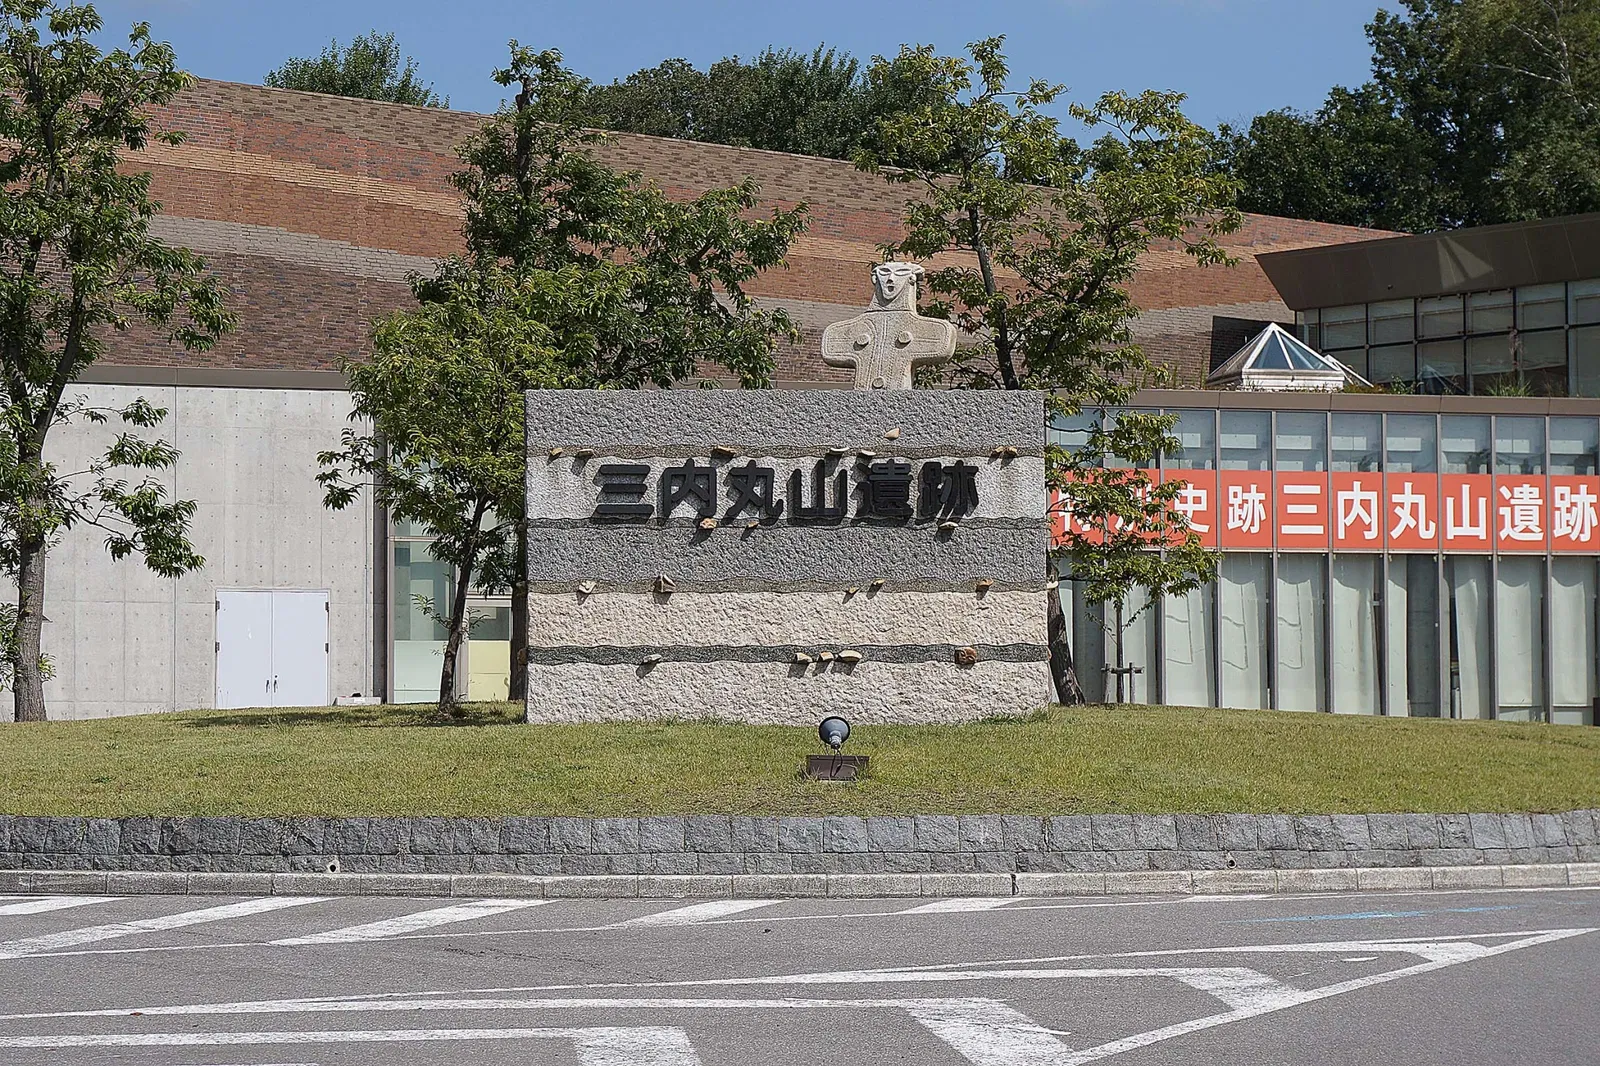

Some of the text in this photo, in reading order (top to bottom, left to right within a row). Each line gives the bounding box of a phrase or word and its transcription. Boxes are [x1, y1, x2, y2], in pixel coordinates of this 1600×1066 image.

[594, 458, 979, 521] 三内丸山遺跡
